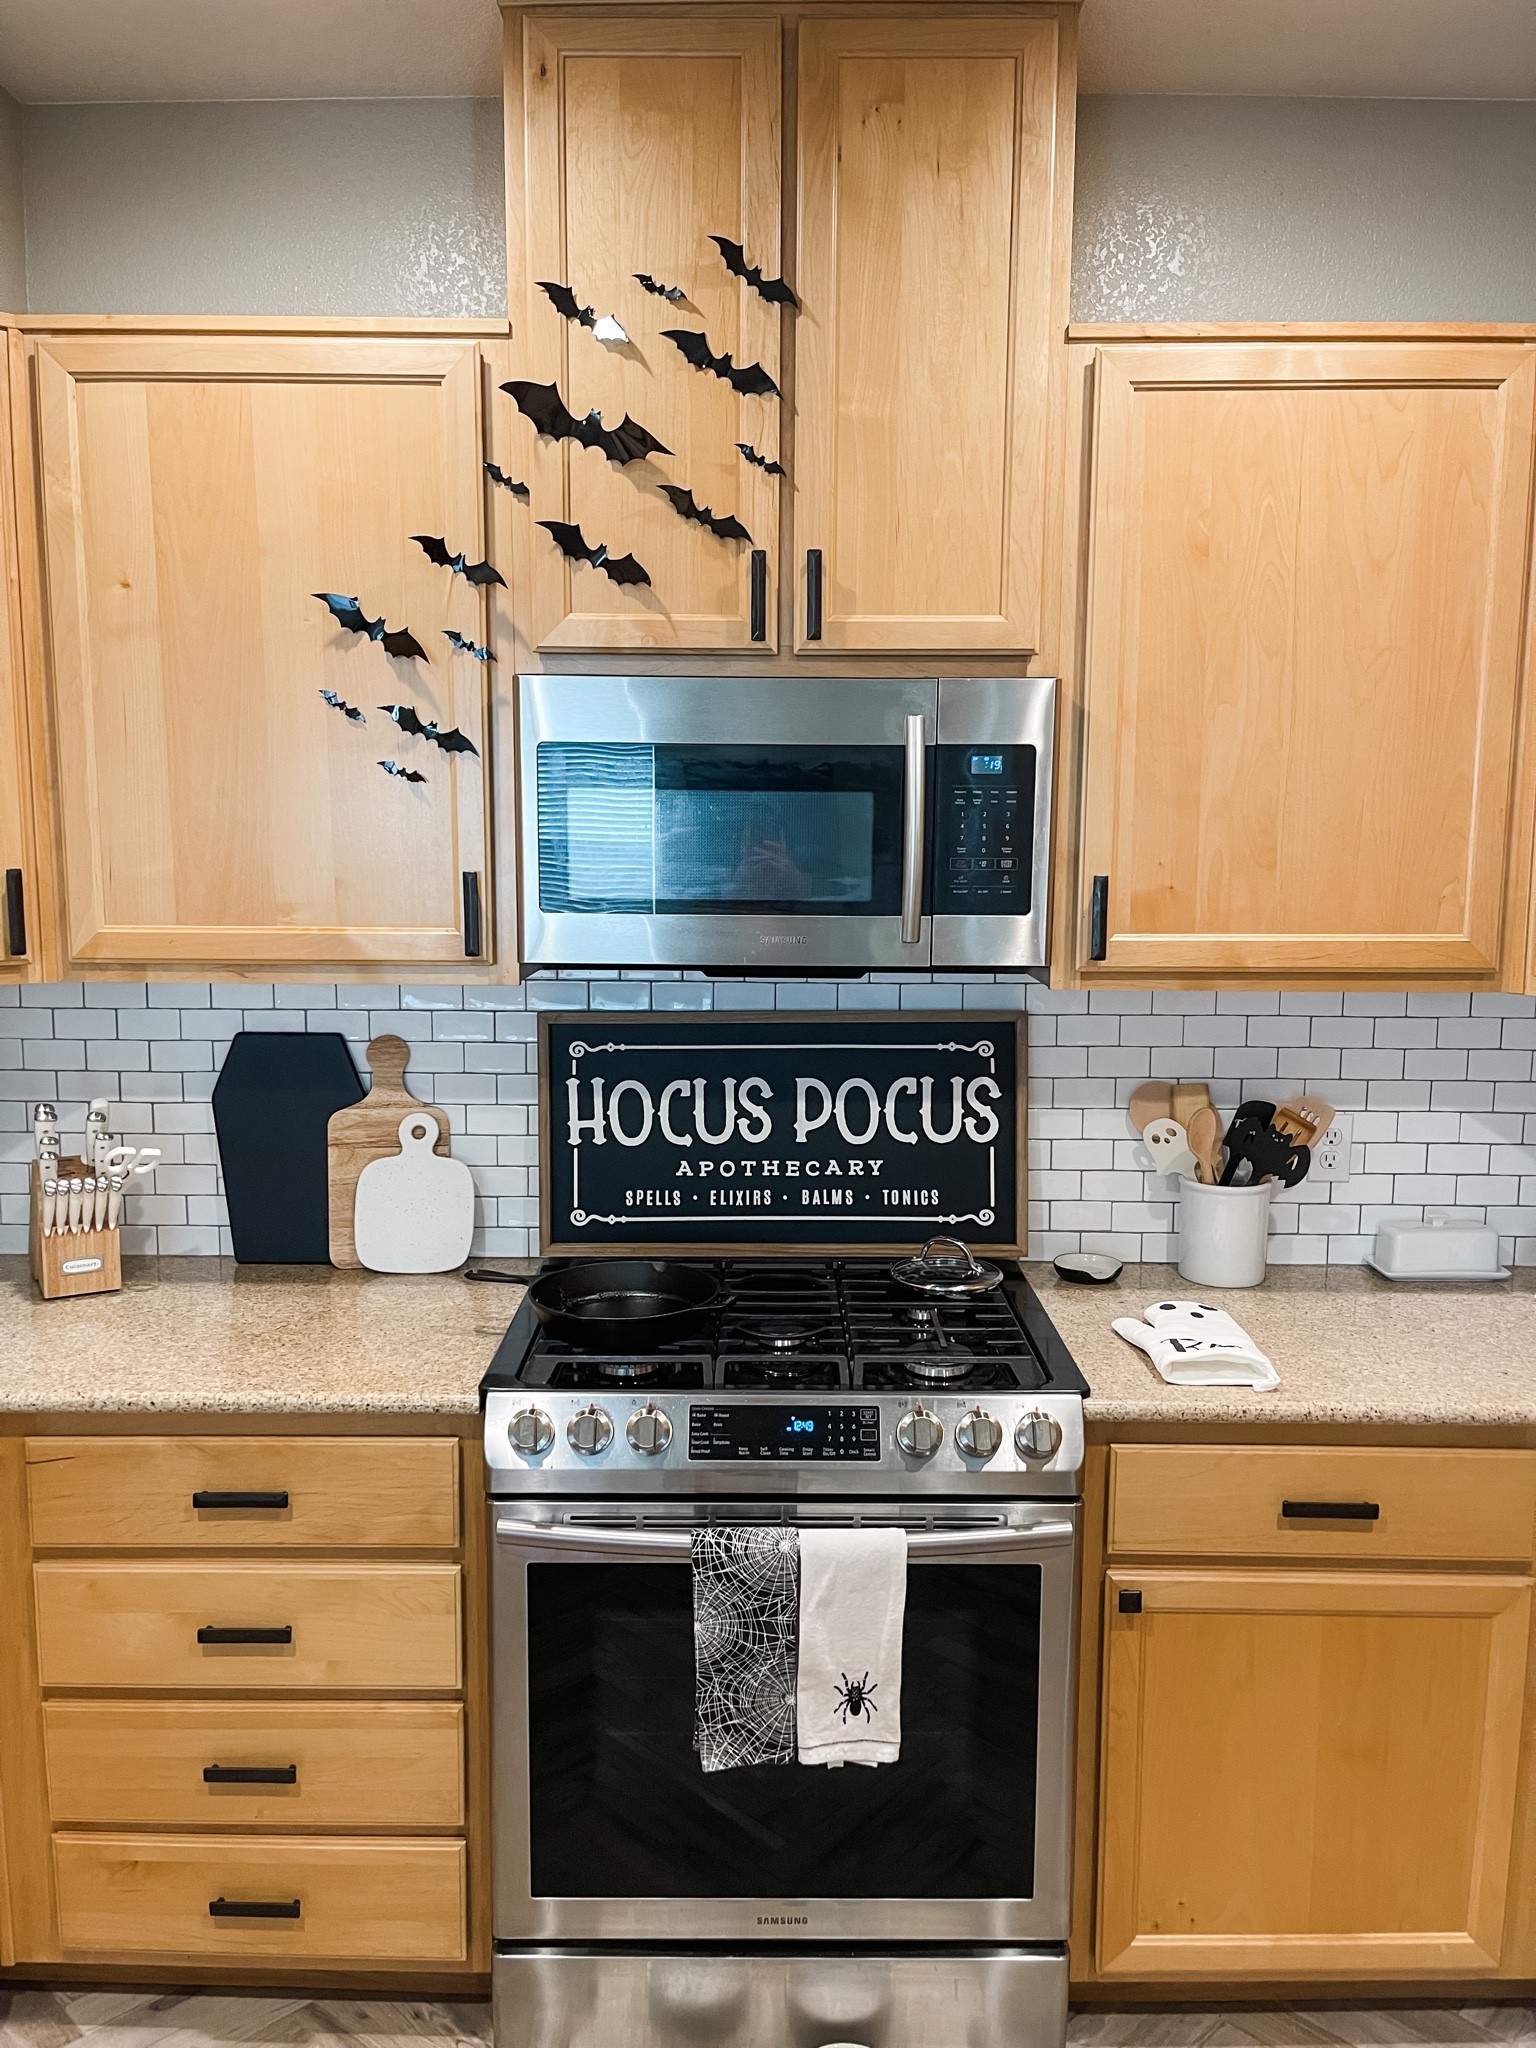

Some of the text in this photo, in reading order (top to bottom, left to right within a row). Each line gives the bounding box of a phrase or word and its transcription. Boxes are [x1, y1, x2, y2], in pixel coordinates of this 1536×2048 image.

[760, 936, 807, 944] SAMSUNG
[566, 1076, 1002, 1147] HOCUS POCUS
[675, 1159, 885, 1177] APOTHECARY
[625, 1189, 940, 1206] SPELLS ELIXIRS BALMS TONICS
[757, 1917, 808, 1925] SAMSUNG
